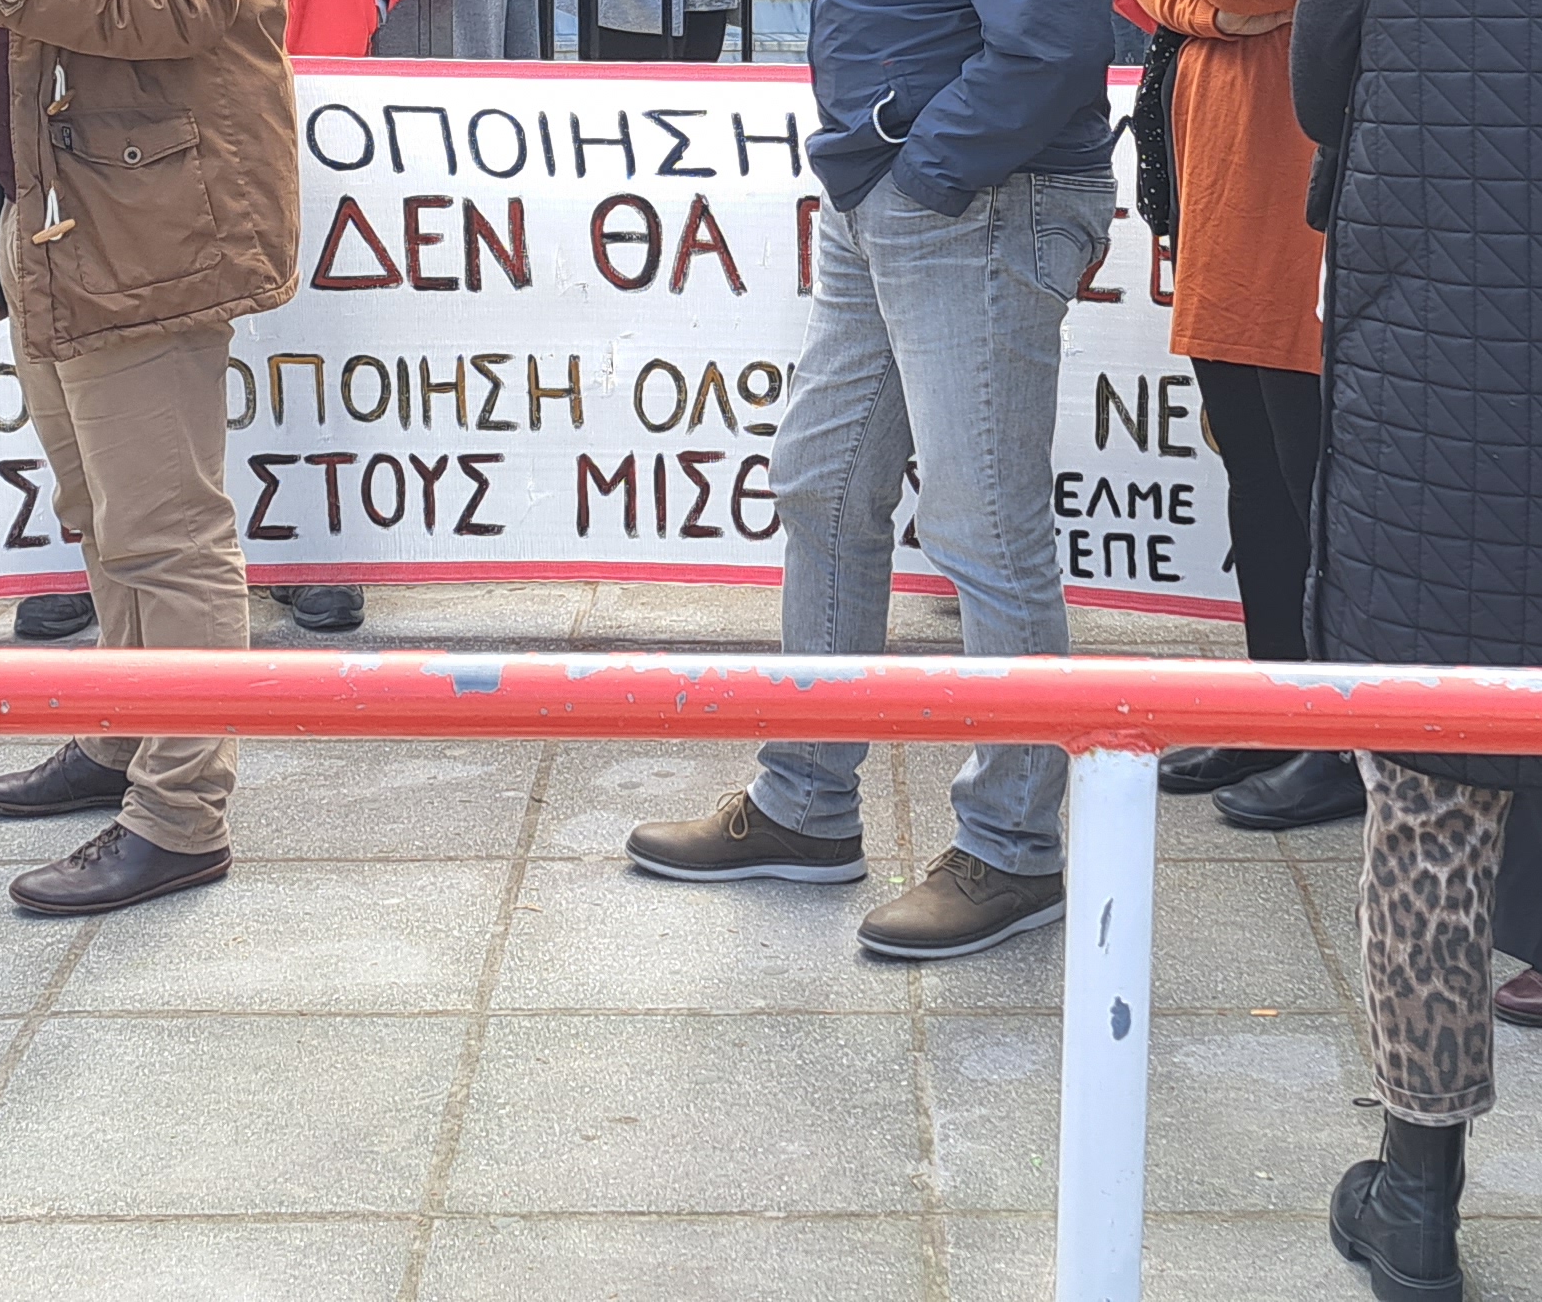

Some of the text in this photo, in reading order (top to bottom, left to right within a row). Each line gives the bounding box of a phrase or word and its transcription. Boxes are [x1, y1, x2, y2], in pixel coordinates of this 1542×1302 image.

[308, 193, 533, 293] ΔΕΝ
[590, 192, 749, 297] ΘΑ
[634, 356, 795, 436] ΟΛΩ
[1095, 372, 1221, 458] ΝΕ
[246, 451, 506, 540] ΣΤΟΥΣ
[1056, 527, 1185, 583] ΕΠΕ
